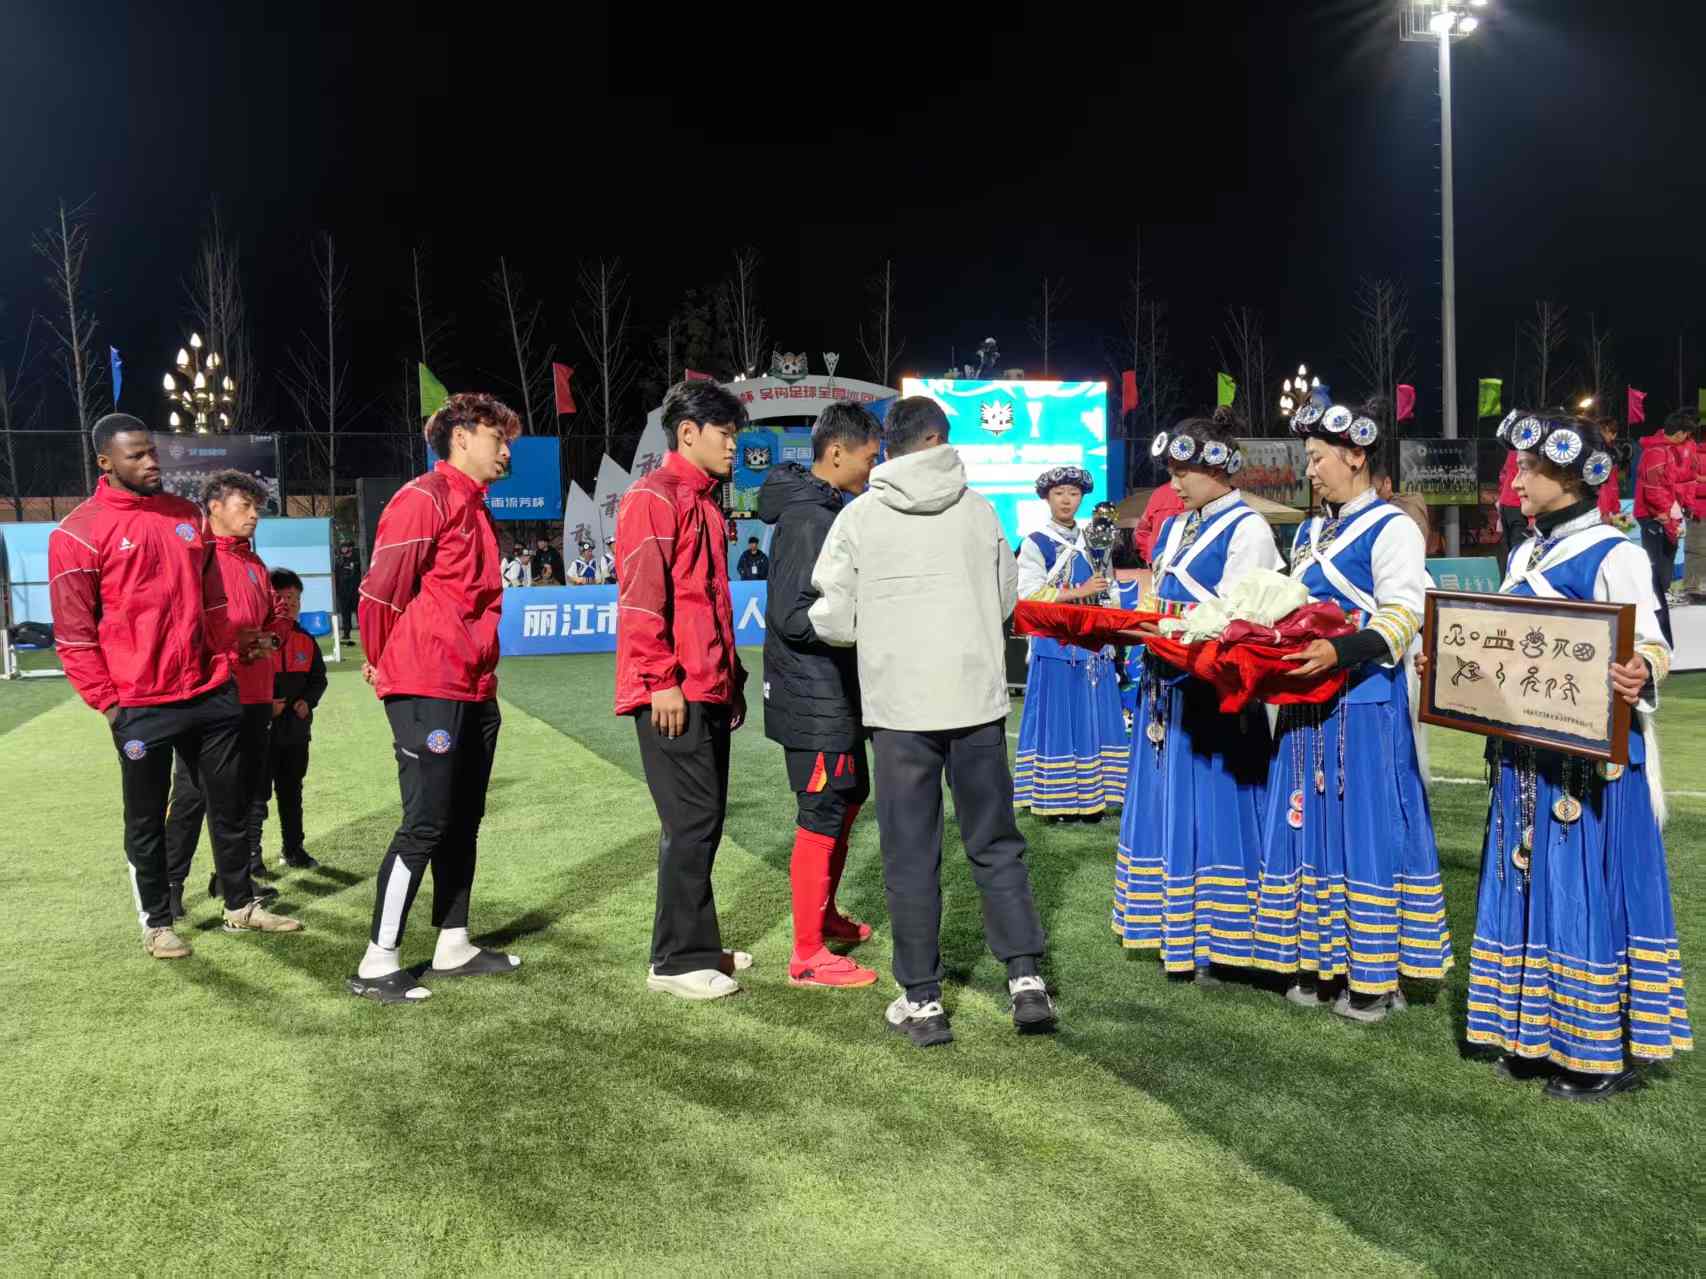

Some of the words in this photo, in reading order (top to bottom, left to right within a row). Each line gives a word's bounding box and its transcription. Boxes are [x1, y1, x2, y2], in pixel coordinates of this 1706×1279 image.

[523, 602, 617, 637] 丽江市
[738, 597, 766, 630] 人
